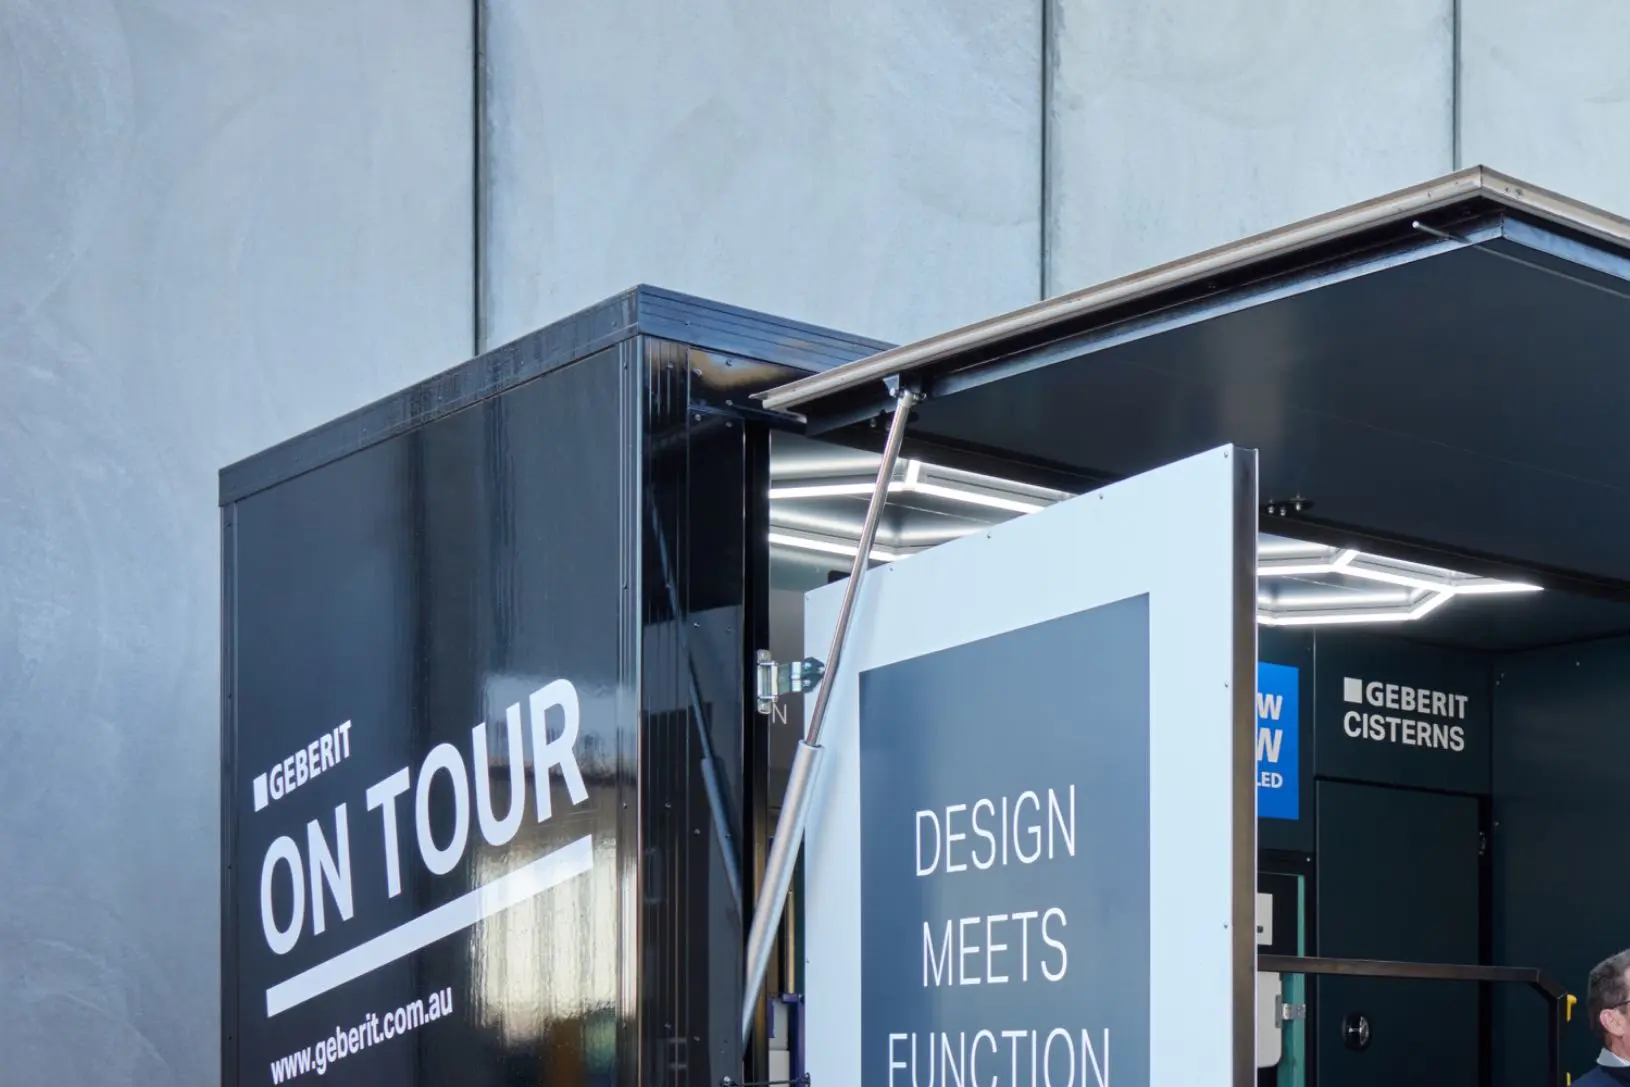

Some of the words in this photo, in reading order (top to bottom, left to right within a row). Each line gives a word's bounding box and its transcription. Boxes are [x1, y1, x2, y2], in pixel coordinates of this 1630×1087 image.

[1343, 711, 1465, 752] CISTERNS
[1365, 681, 1469, 719] GEBERIT
[269, 719, 352, 801] GEBERIT
[260, 803, 354, 956] ON
[366, 678, 589, 899] TOUR
[914, 784, 1077, 877] DESIGN
[922, 907, 1069, 988] MEETS
[270, 986, 453, 1086] www.geberit.com.au
